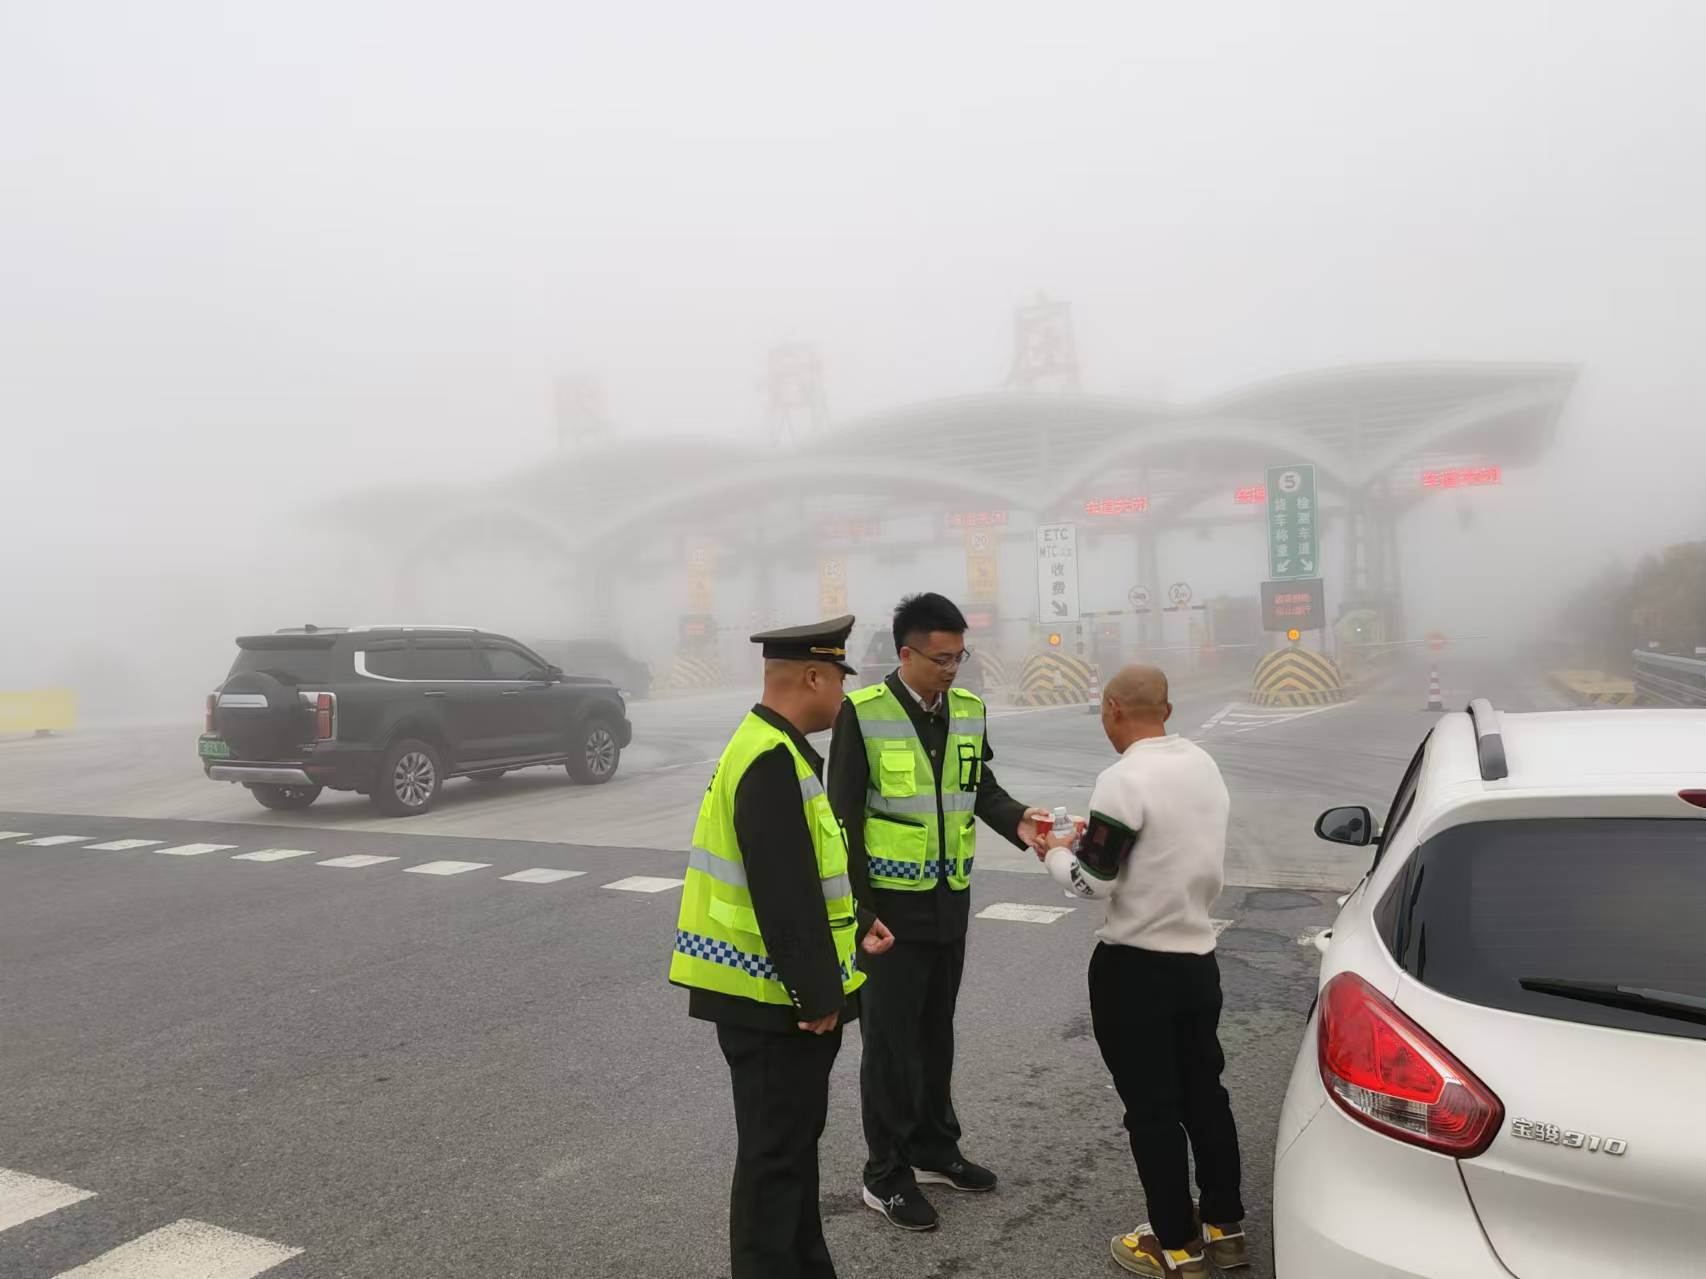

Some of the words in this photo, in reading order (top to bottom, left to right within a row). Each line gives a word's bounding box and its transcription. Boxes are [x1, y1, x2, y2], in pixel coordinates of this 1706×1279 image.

[1283, 474, 1297, 489] 5
[1043, 527, 1070, 542] ETC
[1050, 562, 1067, 596] 收费
[1511, 1118, 1628, 1155] 宝骏310
